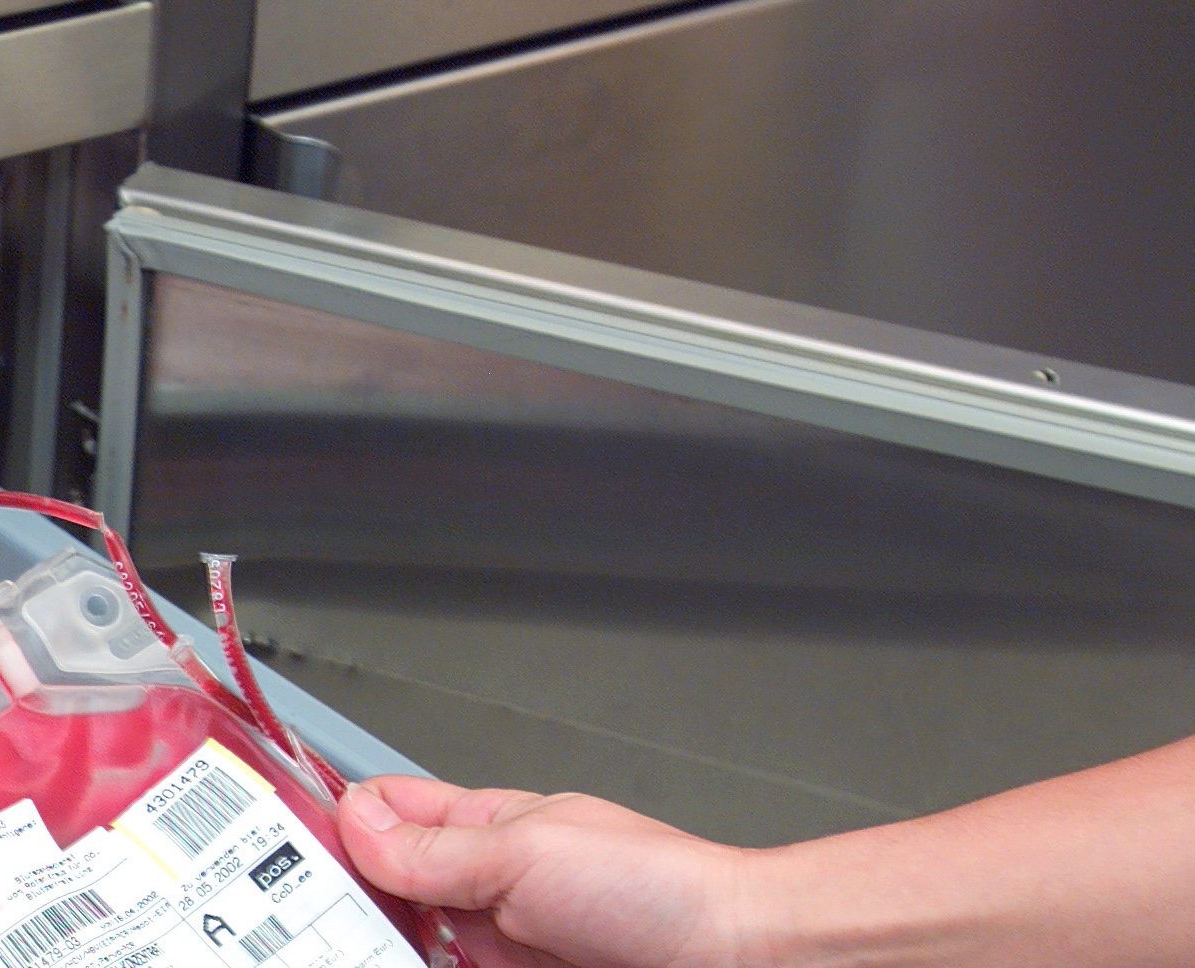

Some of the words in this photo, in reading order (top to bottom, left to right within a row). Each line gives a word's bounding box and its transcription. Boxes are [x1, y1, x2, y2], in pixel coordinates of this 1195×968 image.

[143, 756, 210, 816] 4301479
[176, 854, 244, 912] 28.05.2002
[251, 820, 286, 852] 19:34
[255, 848, 300, 891] pos.
[195, 905, 237, 949] A
